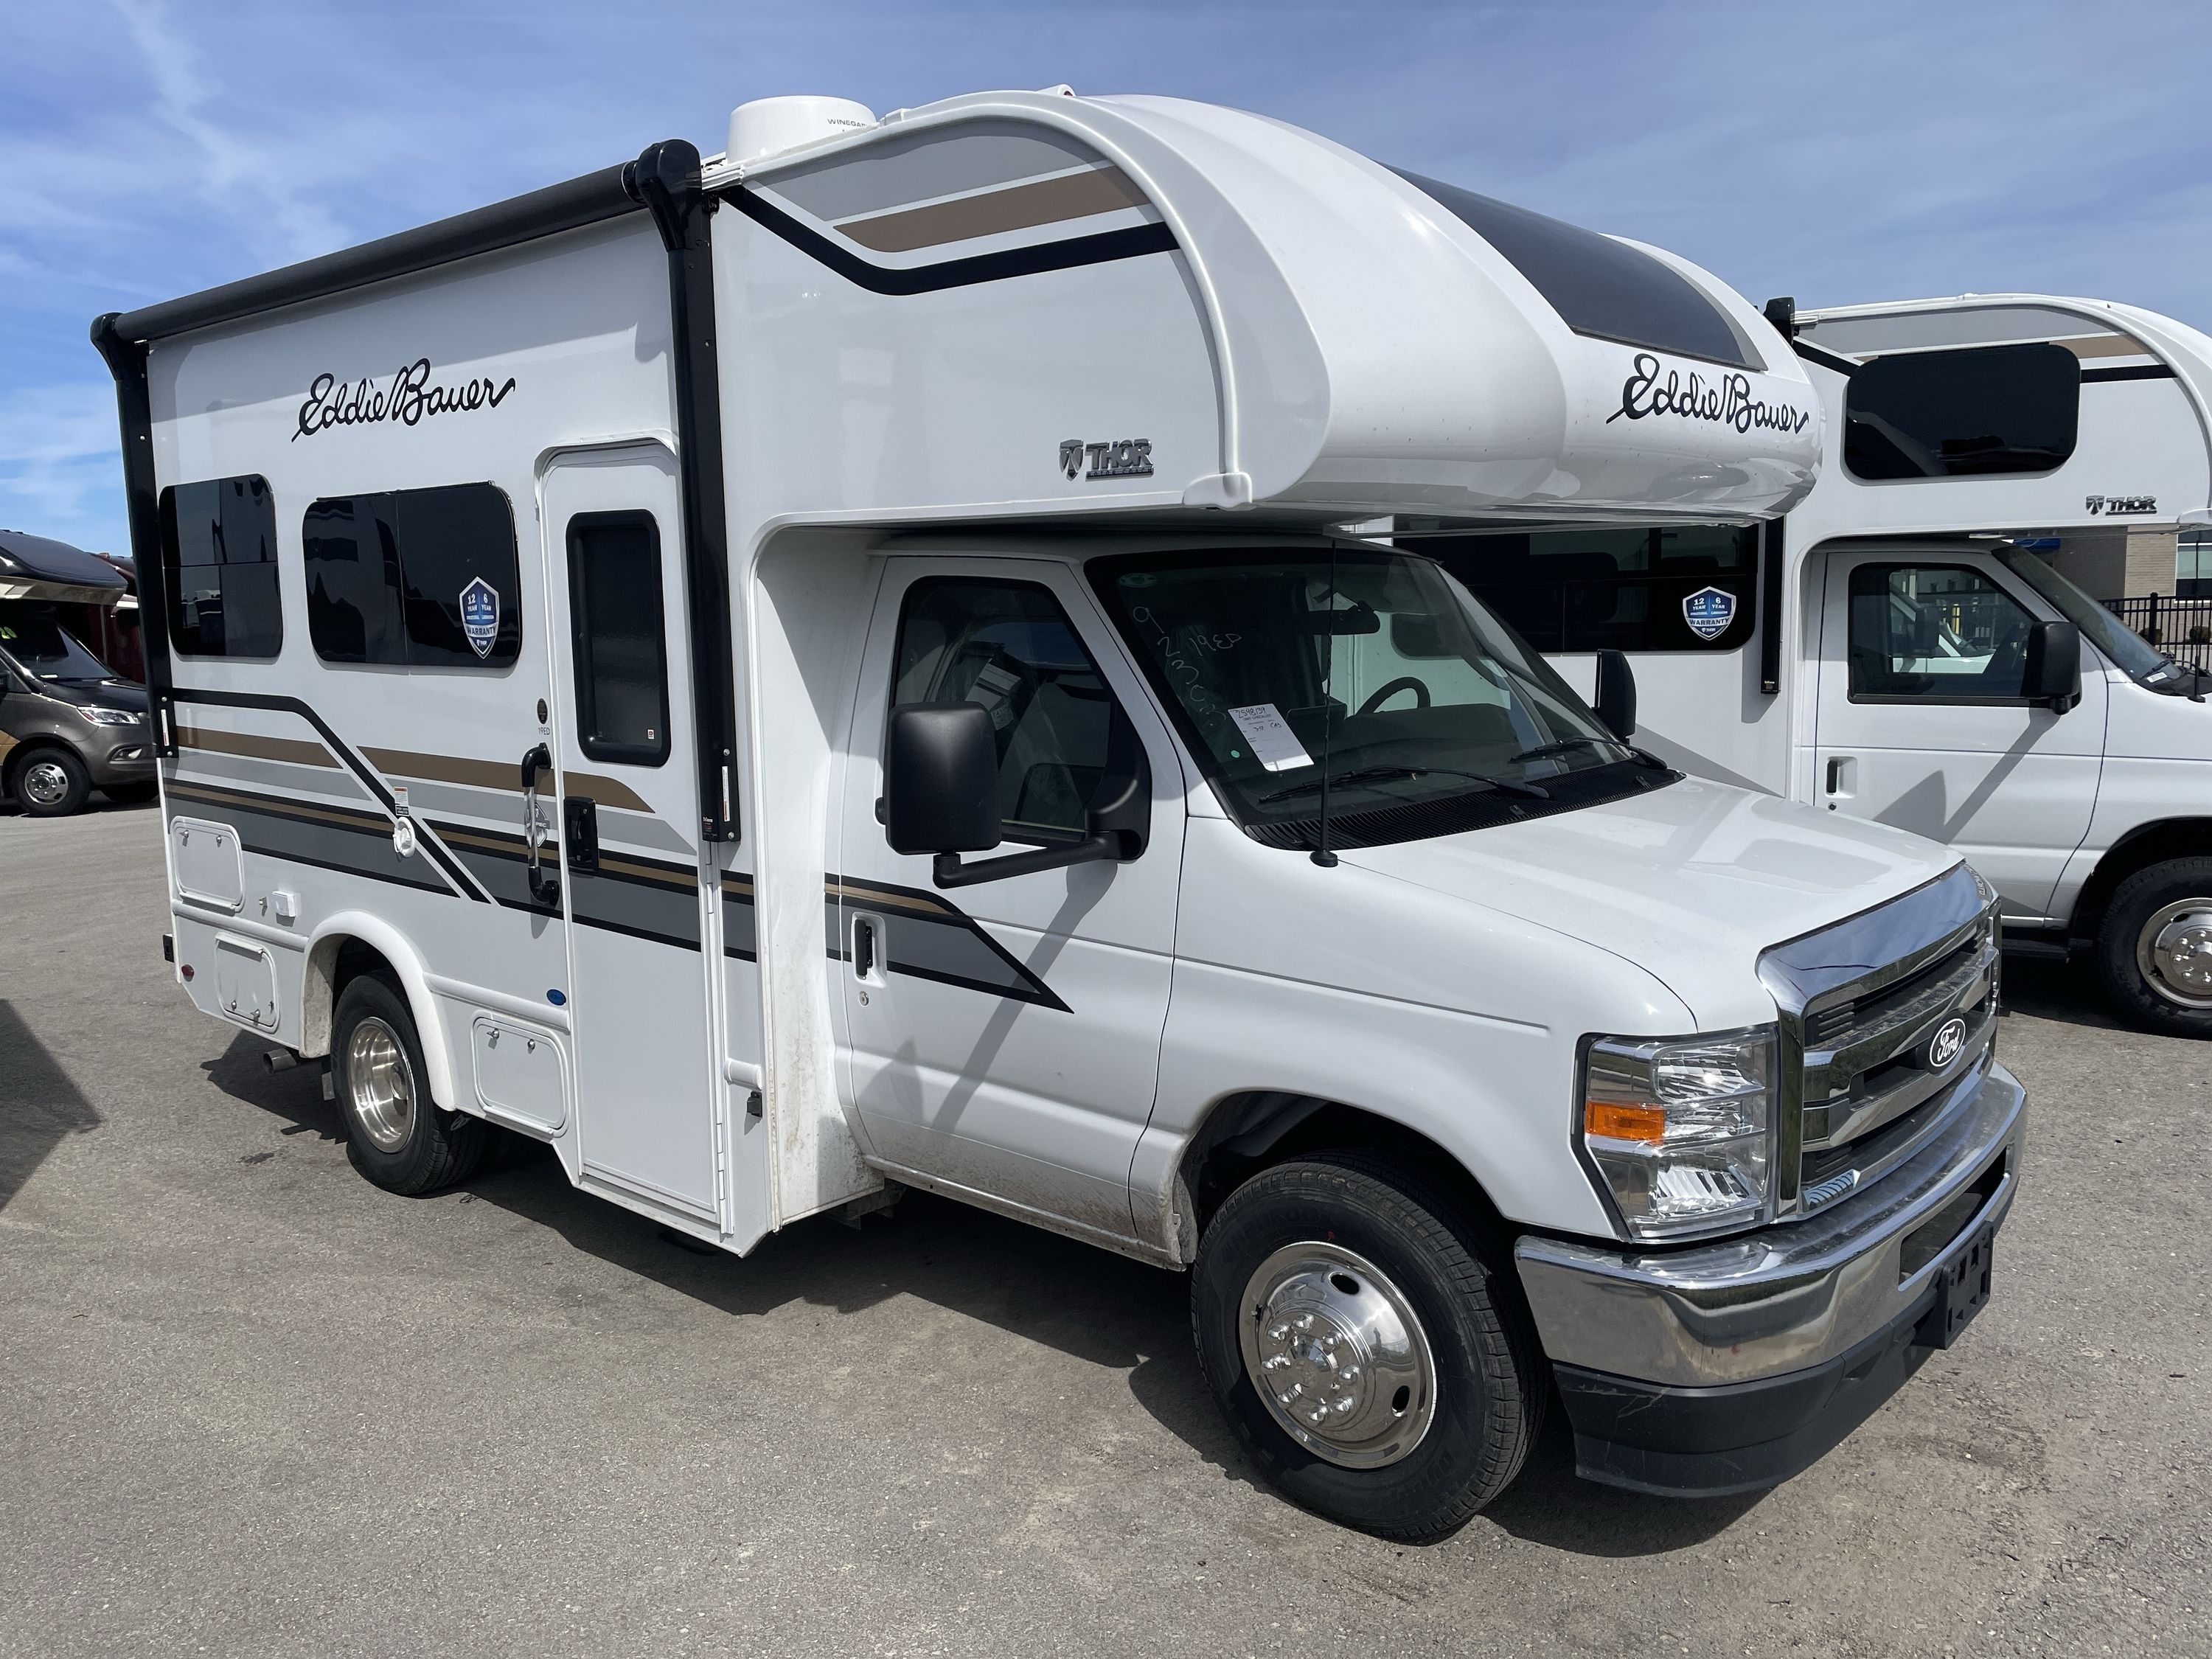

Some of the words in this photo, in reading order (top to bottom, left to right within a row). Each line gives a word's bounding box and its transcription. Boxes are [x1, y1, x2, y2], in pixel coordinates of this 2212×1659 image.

[827, 119, 868, 127] WINEGAR
[1606, 353, 1721, 425] Eddie
[1722, 373, 1809, 434] Bauer
[291, 372, 388, 442] Eddie
[391, 358, 516, 426] Bauer
[1085, 438, 1153, 470] THOR
[2106, 495, 2157, 512] THOR
[467, 594, 476, 605] 12
[483, 593, 488, 603] 6
[1694, 597, 1705, 605] 12
[467, 627, 495, 635] WARRANTY
[538, 727, 550, 735] 19ED
[1937, 1025, 1961, 1062] Ford
